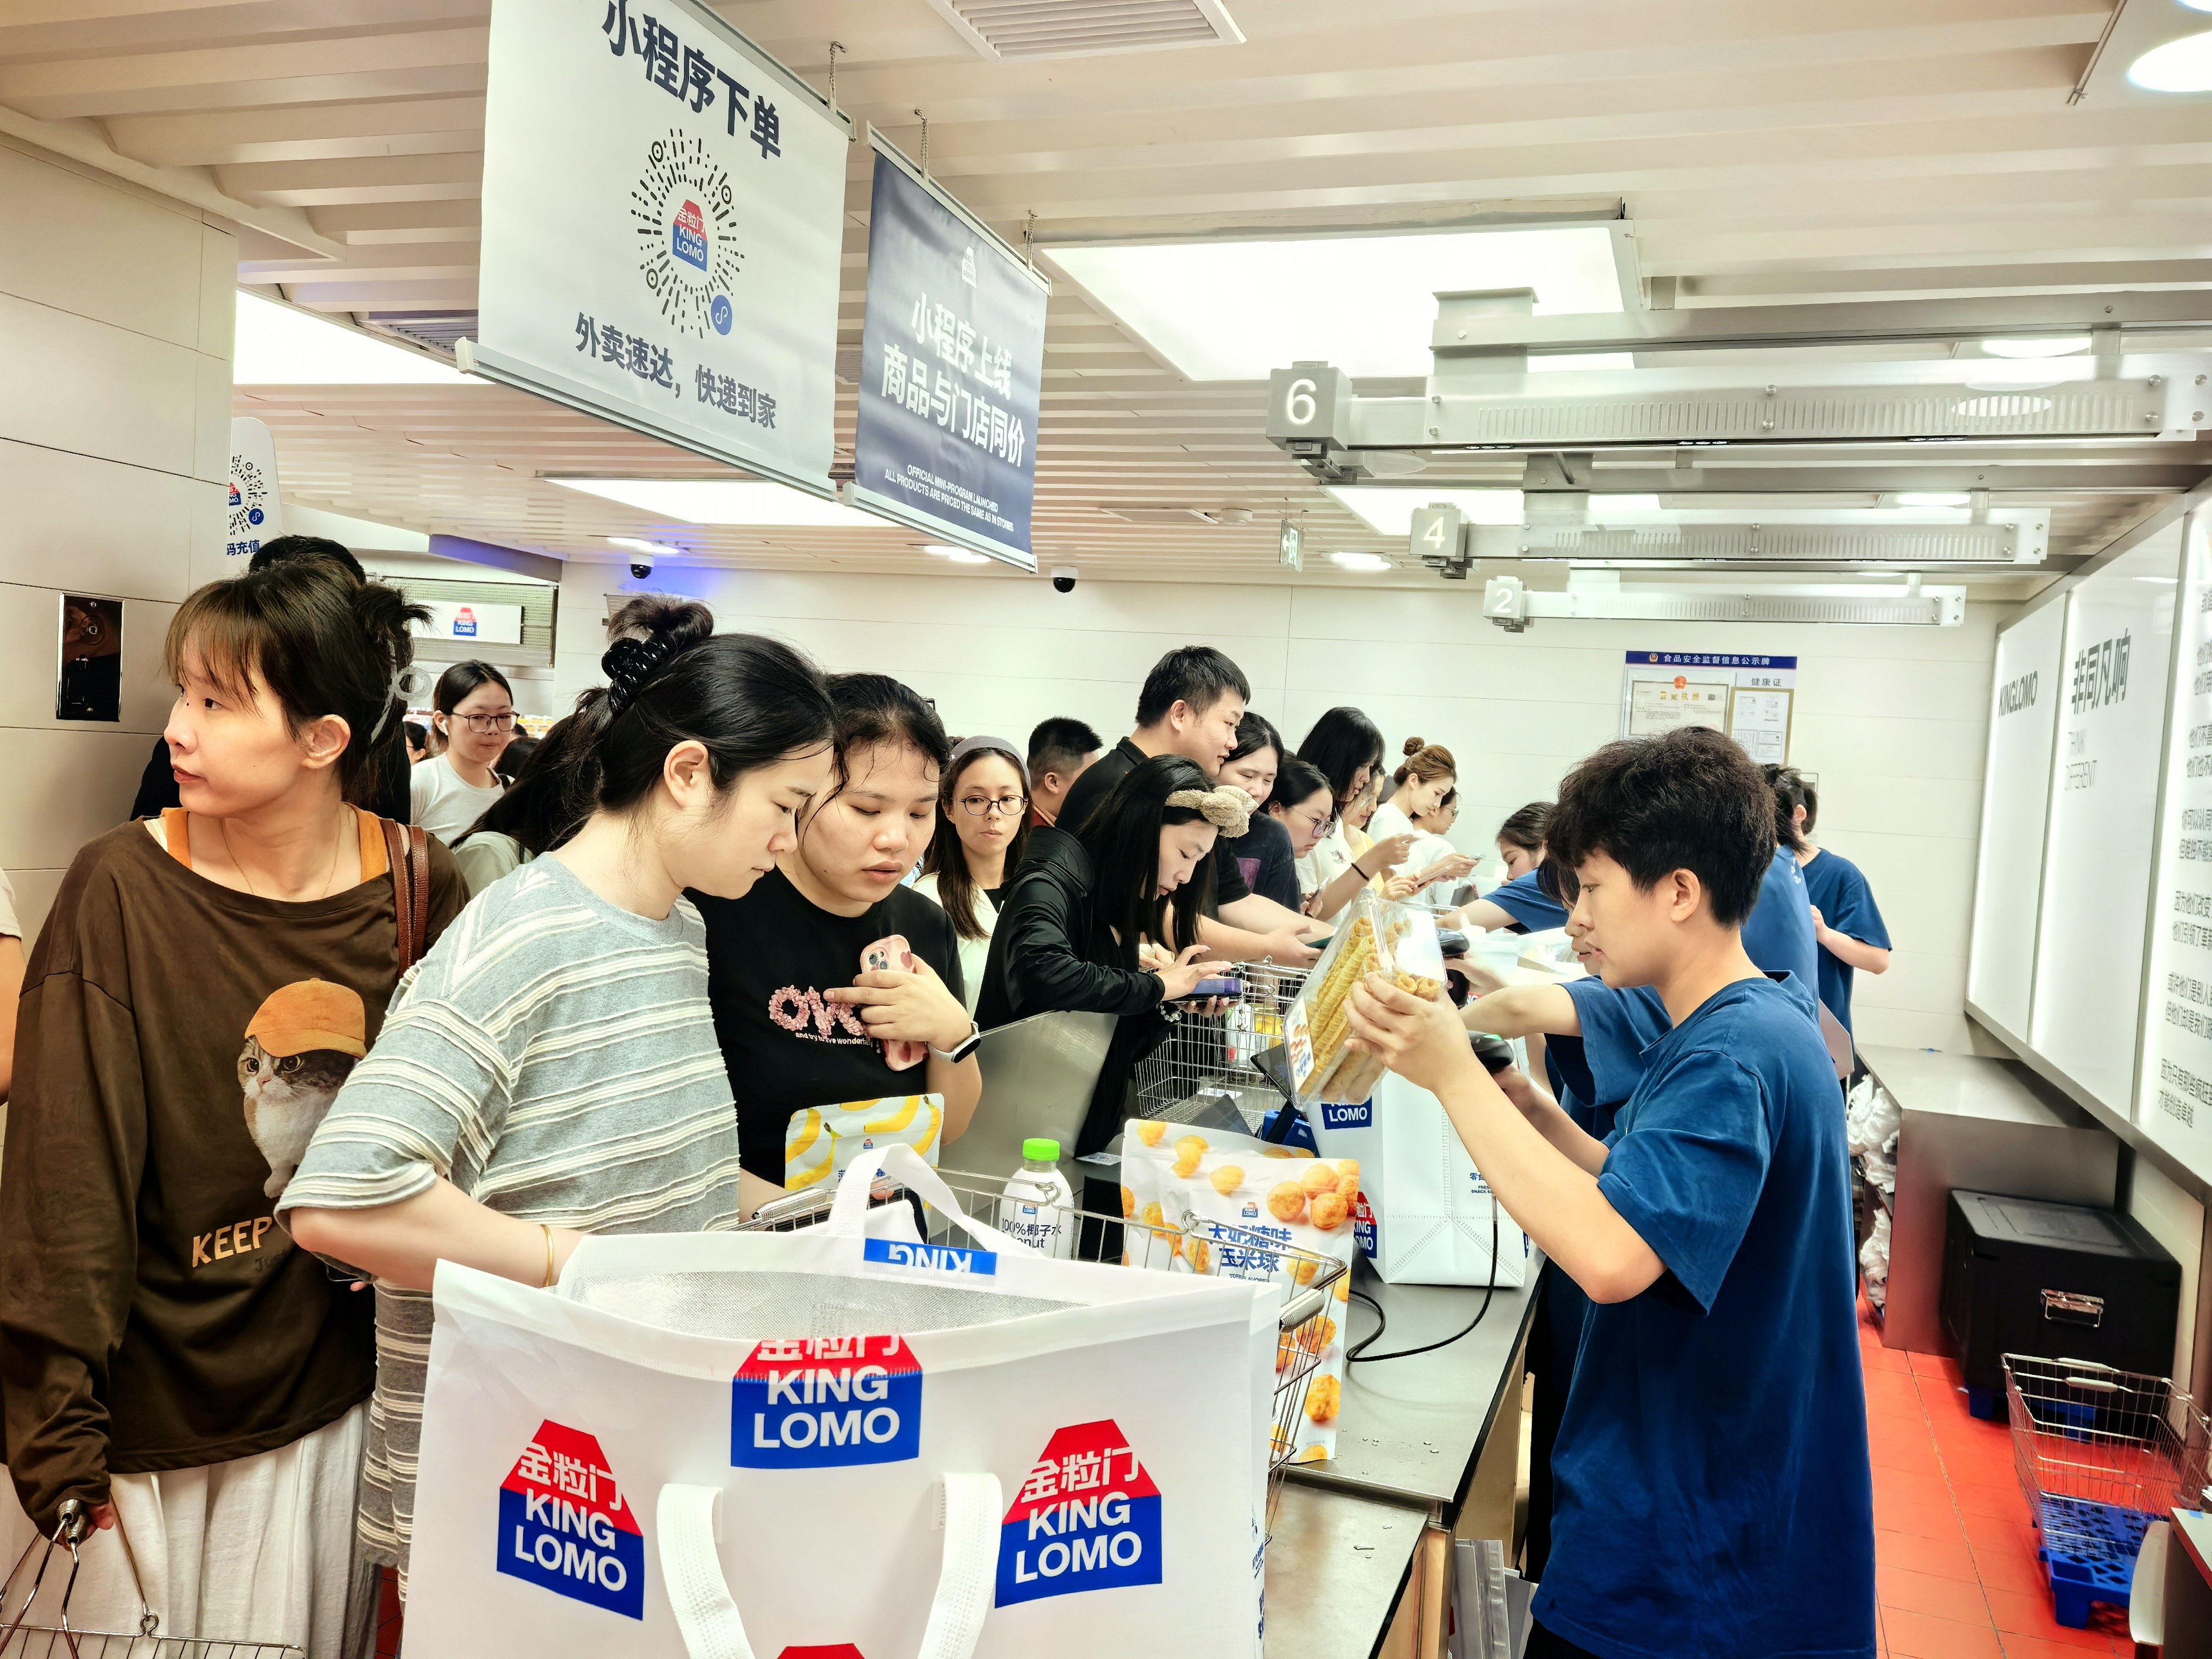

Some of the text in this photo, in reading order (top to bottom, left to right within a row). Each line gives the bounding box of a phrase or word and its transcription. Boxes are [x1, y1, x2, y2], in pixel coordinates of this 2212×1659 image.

[602, 0, 781, 159] 小程序下单
[677, 207, 705, 233] 金粒门
[679, 224, 702, 247] KING
[677, 238, 704, 261] LOMO
[912, 291, 1013, 400] 小程序上线
[881, 343, 1025, 468] 商品与门店同价
[1286, 379, 1317, 425] 6
[885, 468, 896, 483] ALL
[897, 473, 929, 496] PRODUCTS
[929, 487, 941, 502] ARE
[941, 493, 960, 509] PRICED
[960, 500, 972, 514] THE
[970, 504, 984, 520] SAME
[984, 511, 992, 523] AS
[992, 514, 997, 524] IN
[907, 464, 999, 512] OFFICIAL MINI-PROGRAM LAUNCHED
[1424, 516, 1446, 549] 4
[1496, 588, 1514, 613] 2
[1663, 653, 1770, 666] 食品安全监督信息公示牌
[2072, 628, 2132, 715] 非同凡响
[1751, 678, 1782, 687] 健康证
[1999, 670, 2038, 717] KINGLOMO
[808, 1033, 818, 1042] try
[1328, 1107, 1367, 1122] LOMO
[1002, 1218, 1062, 1237] 100%椰子水
[1354, 1220, 1371, 1234] ING
[1356, 1202, 1372, 1218] 粒门
[192, 1216, 272, 1268] KEEP
[887, 1243, 973, 1274] KING
[1219, 1247, 1280, 1272] 玉米球
[1355, 1236, 1373, 1250] OMO
[767, 1365, 889, 1405] KING
[754, 1407, 900, 1448] LOMO
[517, 1441, 622, 1511] 金粒门
[1021, 1446, 1139, 1504] 金粒门
[525, 1493, 616, 1551] KING
[1028, 1492, 1131, 1541] KING
[514, 1525, 628, 1592] LOMO
[1015, 1531, 1142, 1584] LOMO
